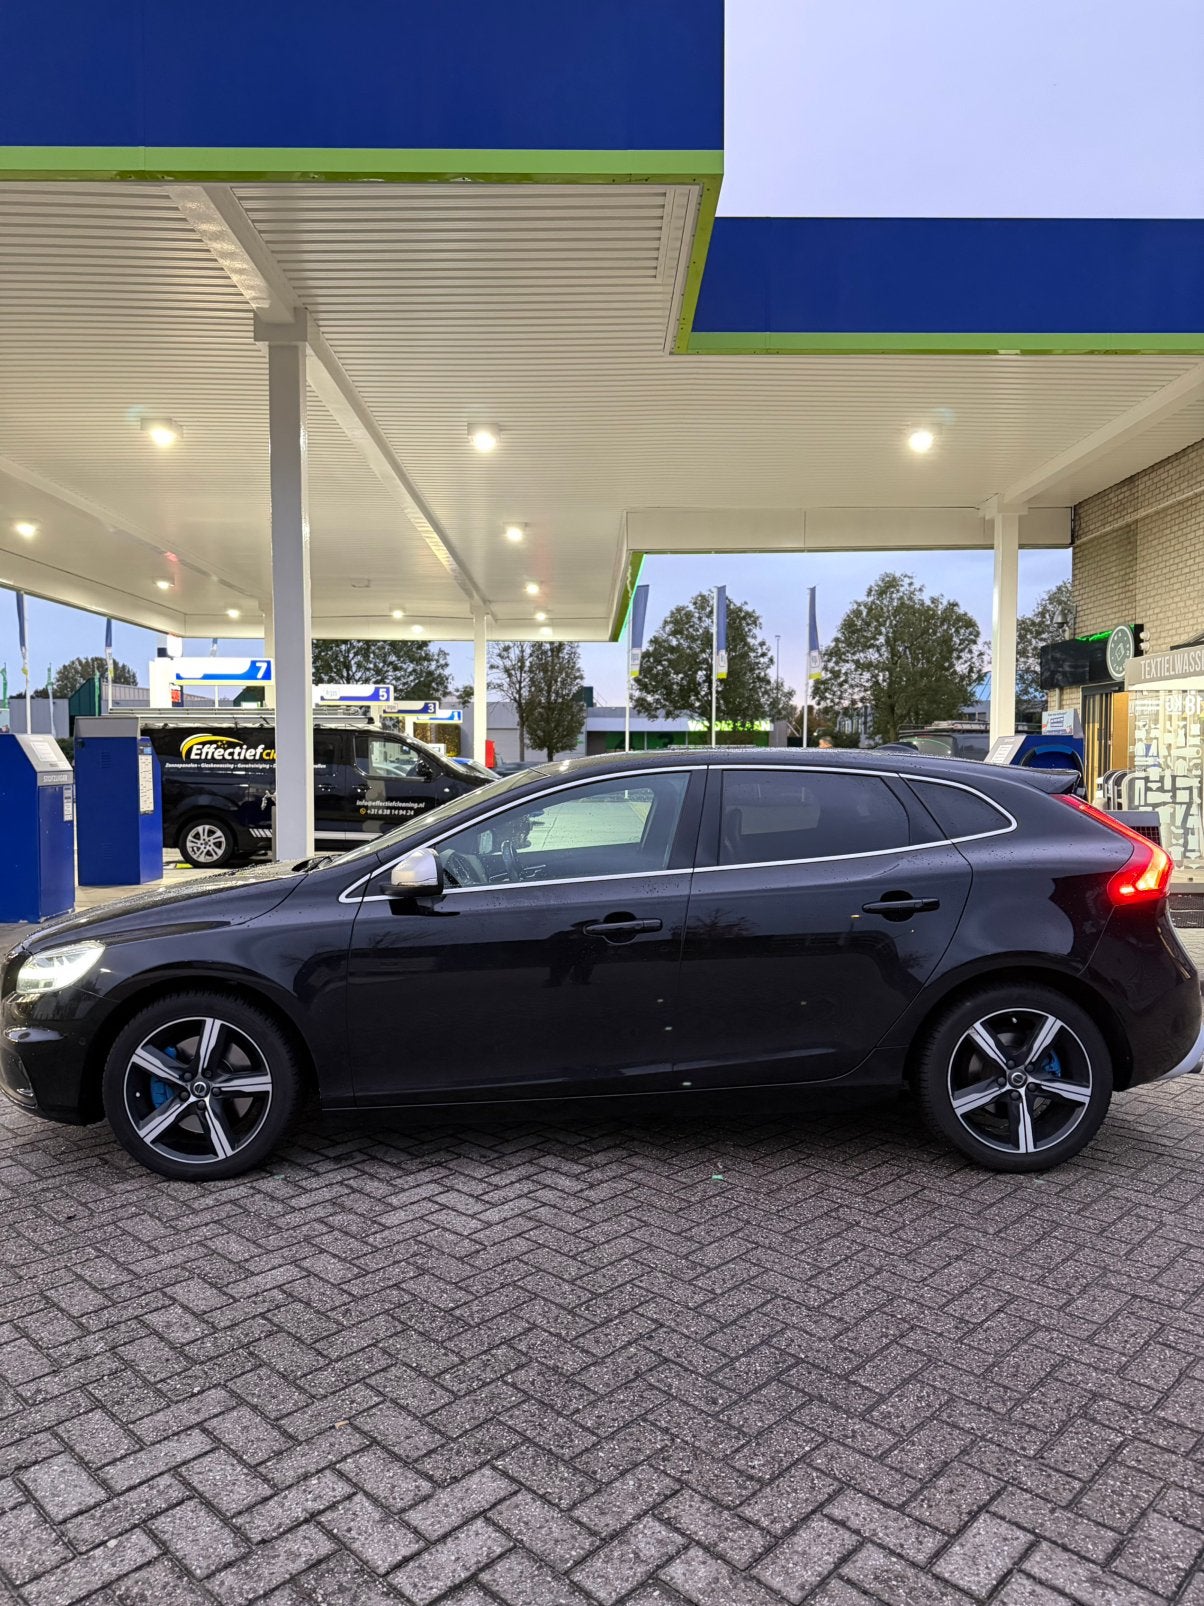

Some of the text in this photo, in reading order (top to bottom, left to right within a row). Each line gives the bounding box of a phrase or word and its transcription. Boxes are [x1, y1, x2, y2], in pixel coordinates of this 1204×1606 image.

[256, 662, 268, 679] 7
[379, 688, 388, 700] 5
[427, 703, 435, 713] 3
